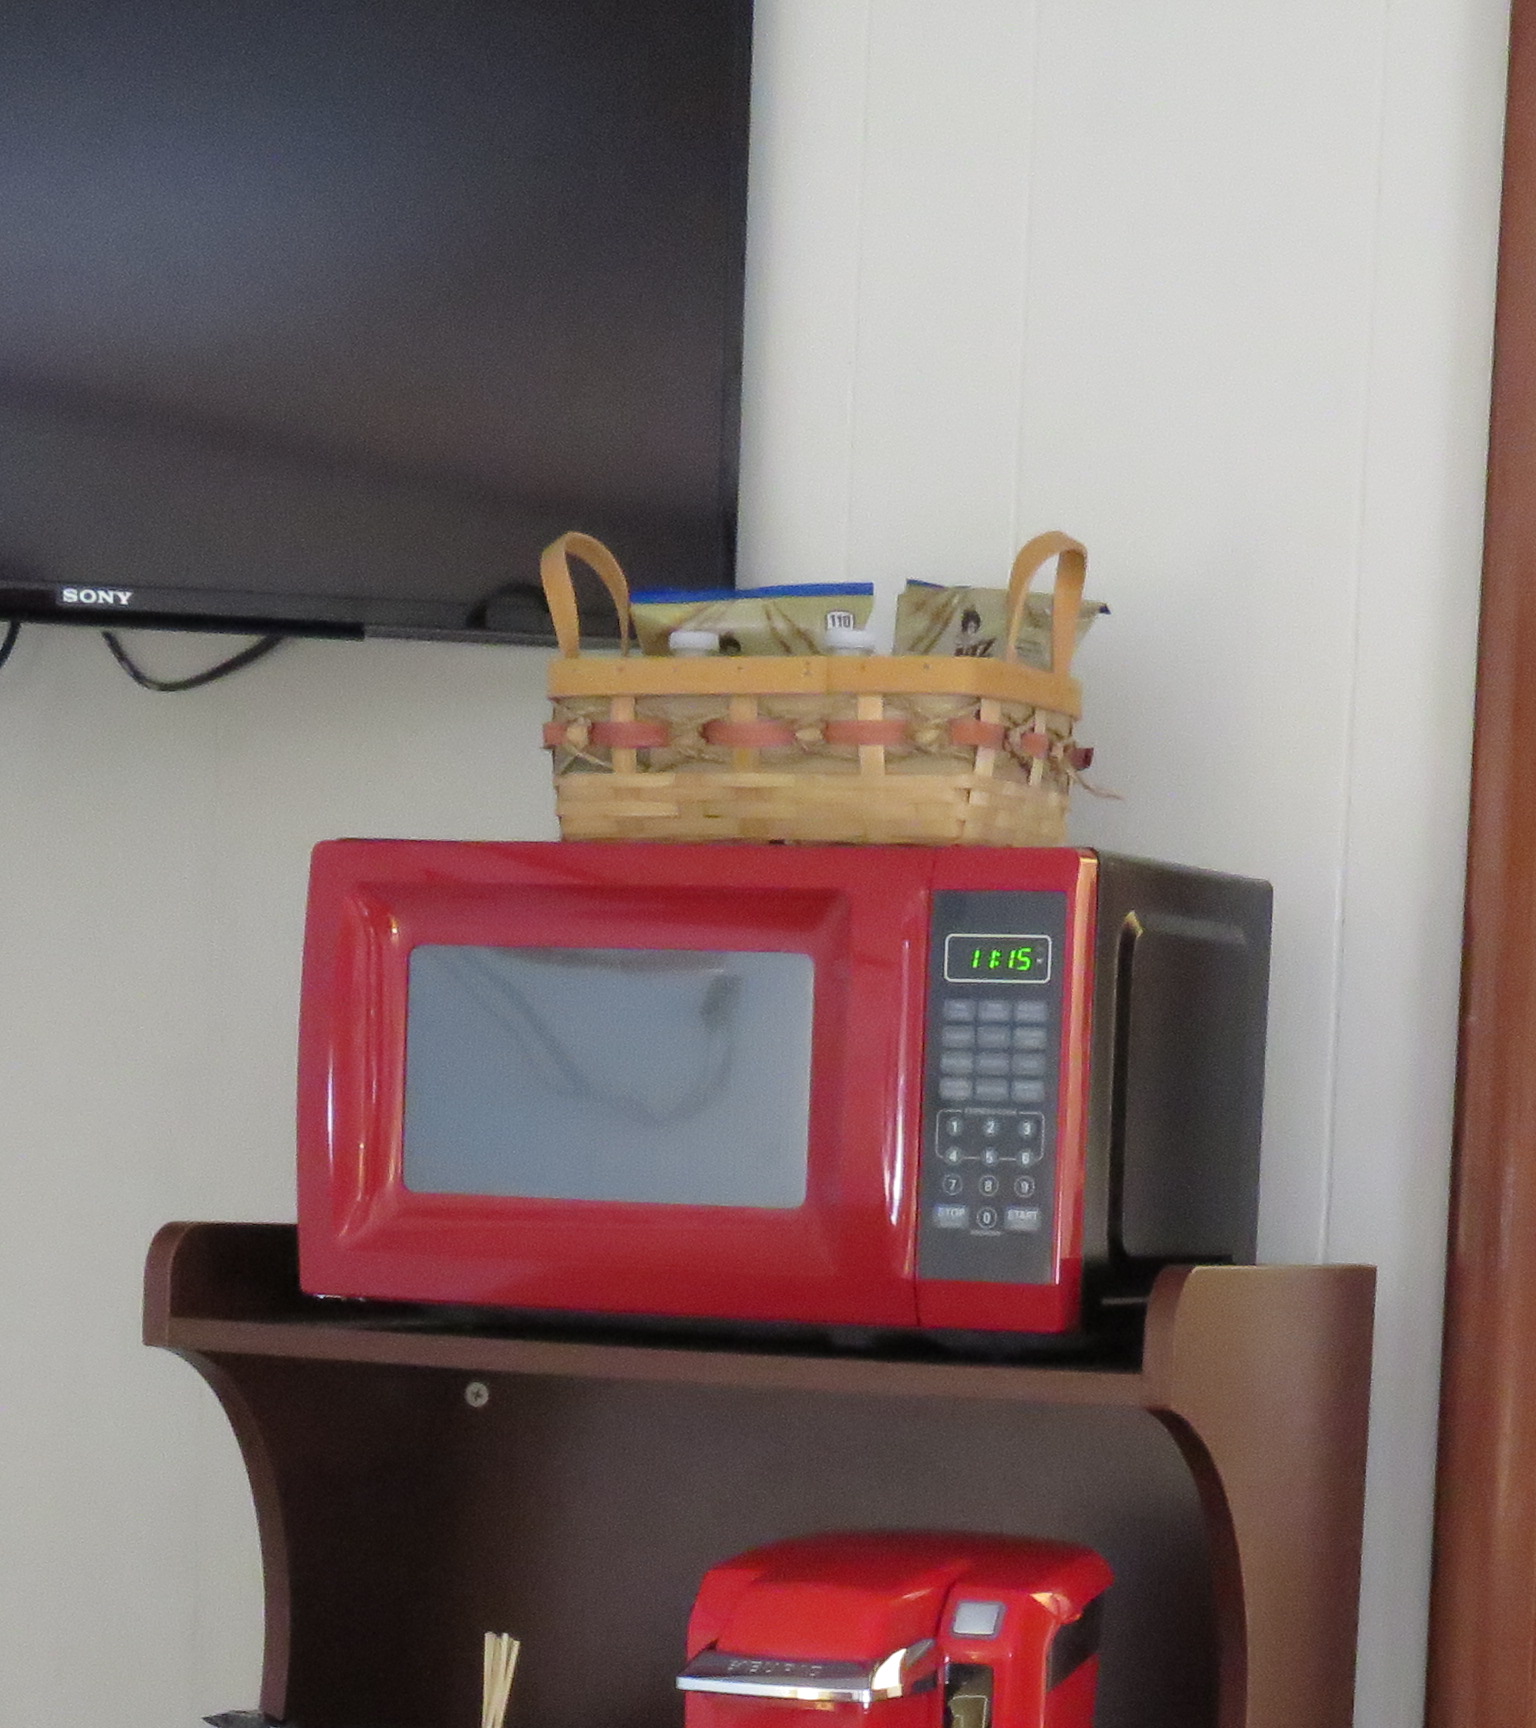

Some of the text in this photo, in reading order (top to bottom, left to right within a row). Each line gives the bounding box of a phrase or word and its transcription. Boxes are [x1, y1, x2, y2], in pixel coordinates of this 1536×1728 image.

[62, 587, 133, 606] SONY
[830, 614, 852, 629] 110
[972, 947, 1032, 971] 11:15
[937, 1206, 966, 1217] STOP
